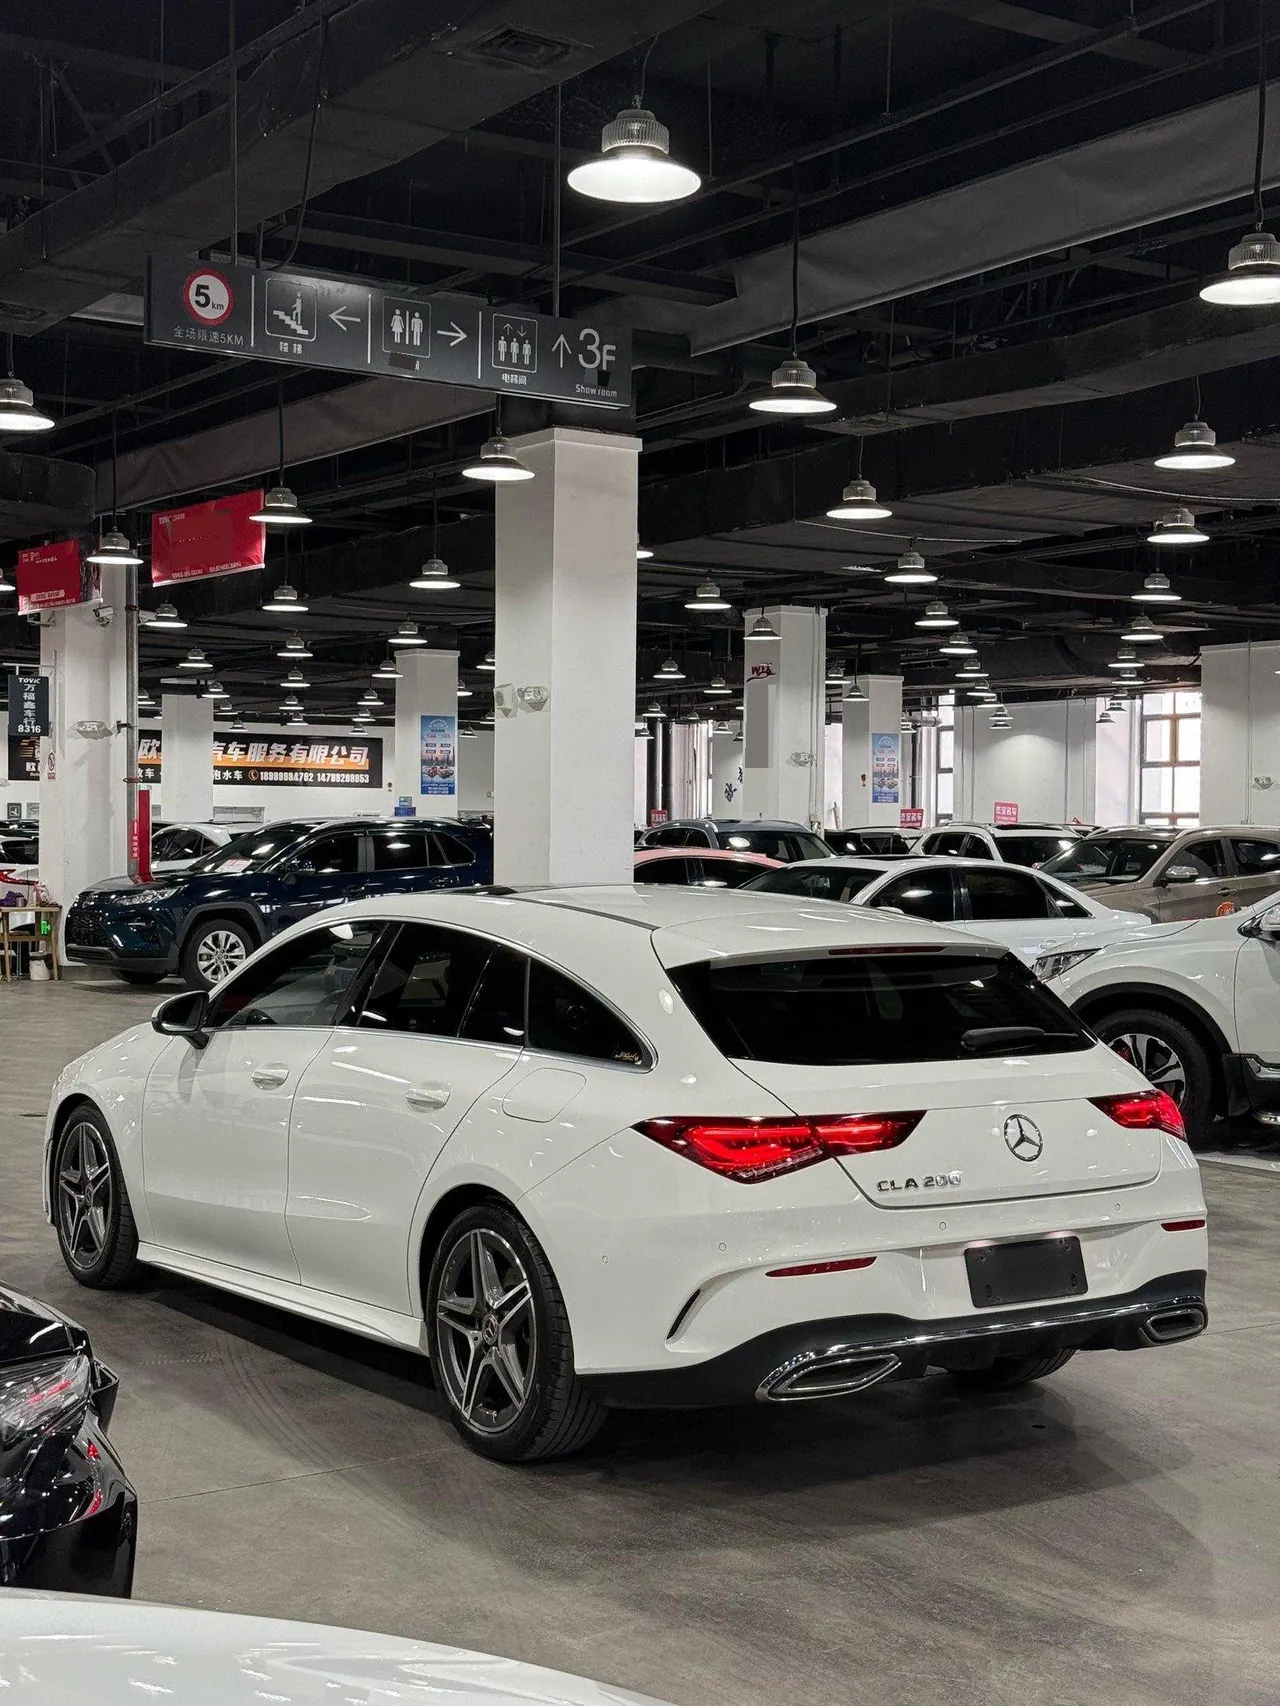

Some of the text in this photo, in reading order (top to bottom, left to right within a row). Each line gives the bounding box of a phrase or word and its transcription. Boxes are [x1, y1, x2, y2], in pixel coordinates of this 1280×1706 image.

[173, 325, 244, 346] 全场限速5KM
[17, 725, 41, 733] 8316
[877, 1173, 962, 1192] CLA 200
